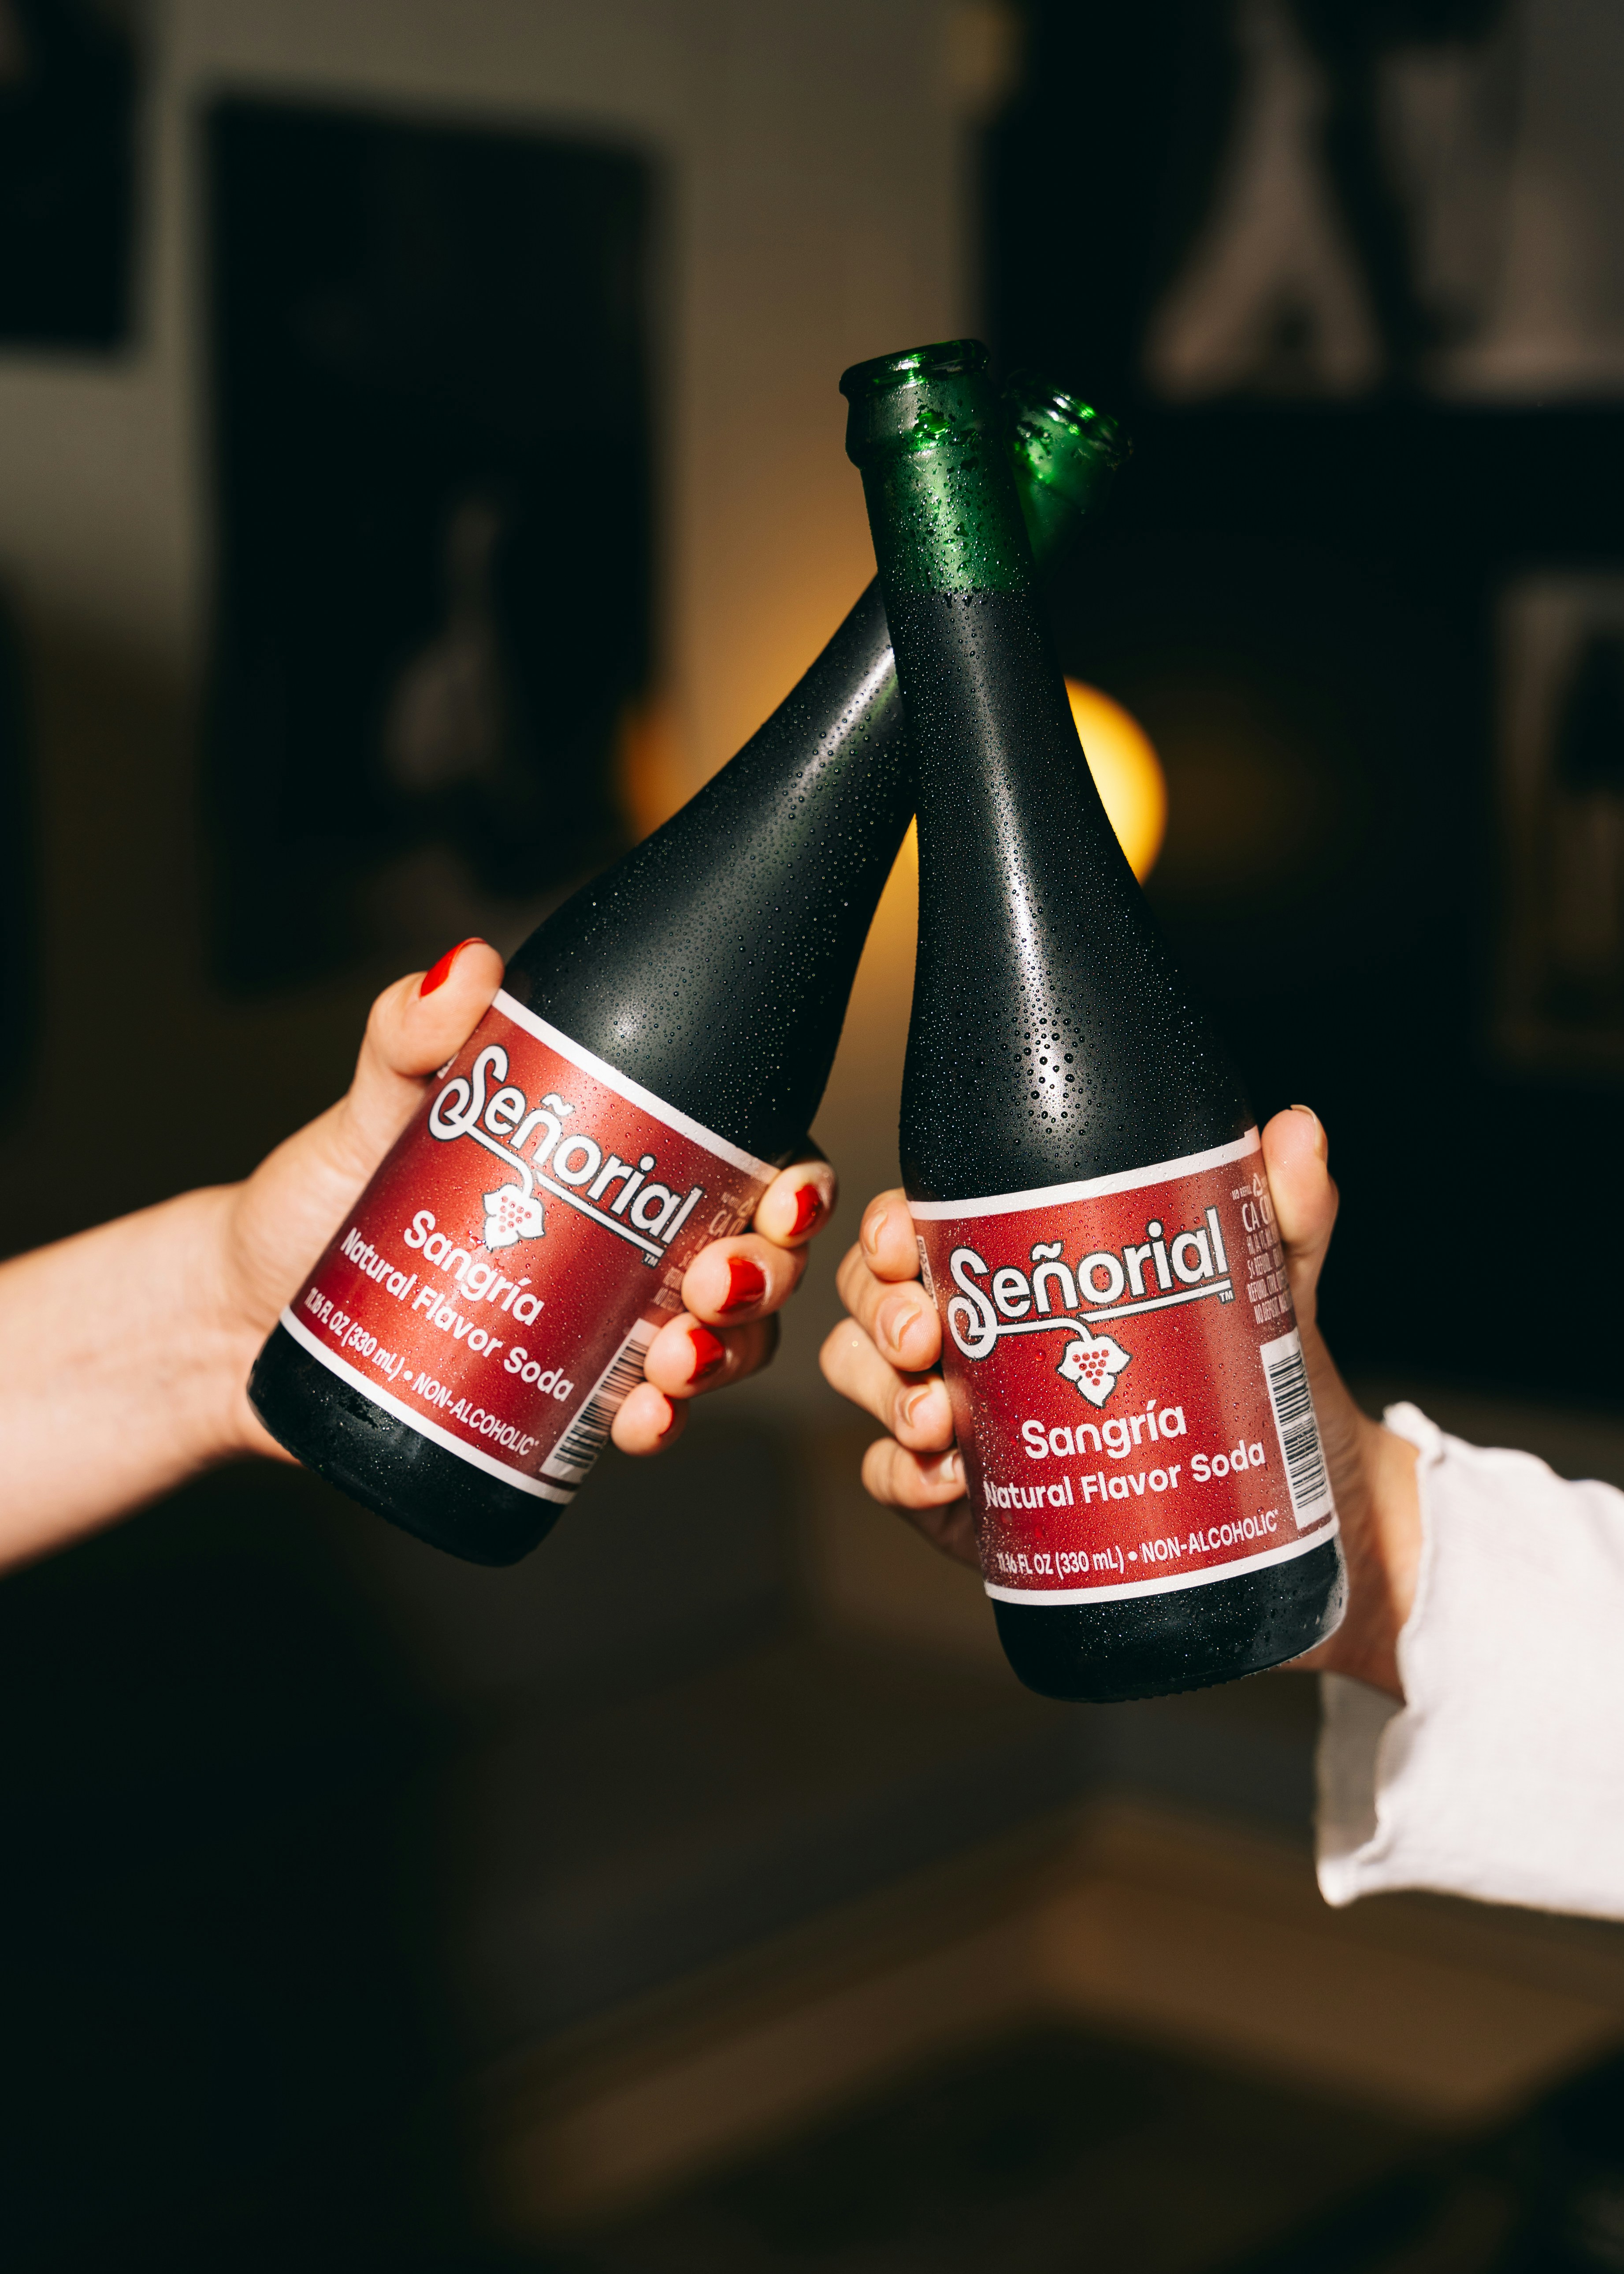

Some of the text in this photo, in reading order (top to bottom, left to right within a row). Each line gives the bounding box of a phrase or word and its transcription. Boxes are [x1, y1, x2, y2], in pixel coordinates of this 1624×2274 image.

[428, 1044, 703, 1244] Señorial
[1242, 1201, 1260, 1232] CA
[403, 1210, 545, 1325] Sangría
[948, 1207, 1228, 1360] Señorial
[318, 1299, 334, 1325] FL
[329, 1311, 351, 1337] OZ
[341, 1322, 378, 1357] (330
[372, 1347, 405, 1382] mL)
[340, 1226, 574, 1403] Natural Flavor Soda
[1022, 1399, 1187, 1460] Sangría
[983, 1438, 1266, 1510] Natural Flavor Soda
[1018, 1553, 1033, 1575] FL
[1033, 1553, 1054, 1574] OZ
[1055, 1551, 1089, 1580] (330
[1093, 1545, 1124, 1574] mL)
